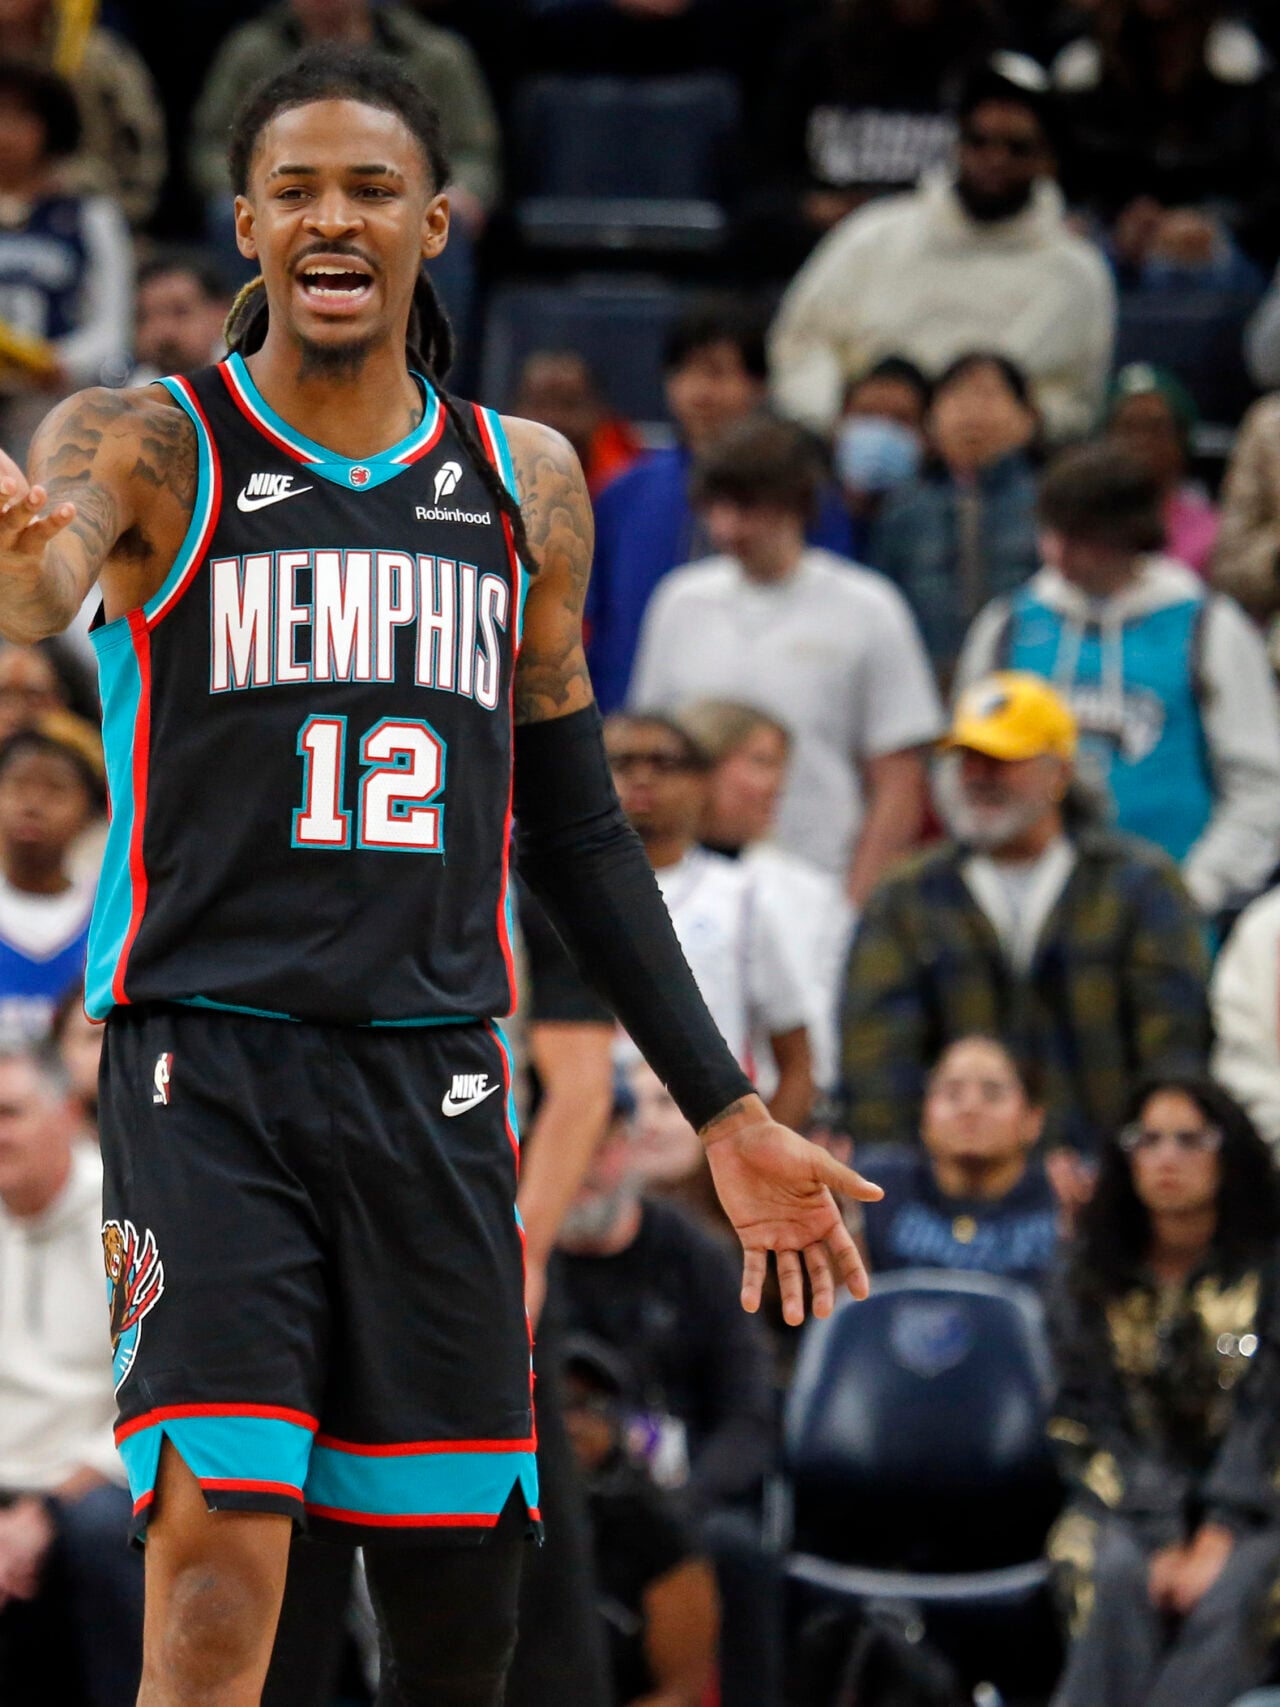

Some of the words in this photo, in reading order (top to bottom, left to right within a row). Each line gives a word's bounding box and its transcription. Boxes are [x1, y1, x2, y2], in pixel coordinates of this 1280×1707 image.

[246, 473, 294, 496] NIKE
[415, 506, 491, 525] Robinhood
[209, 548, 509, 711] MEMPHIS
[291, 714, 447, 854] 12
[450, 1074, 488, 1099] NIKE
